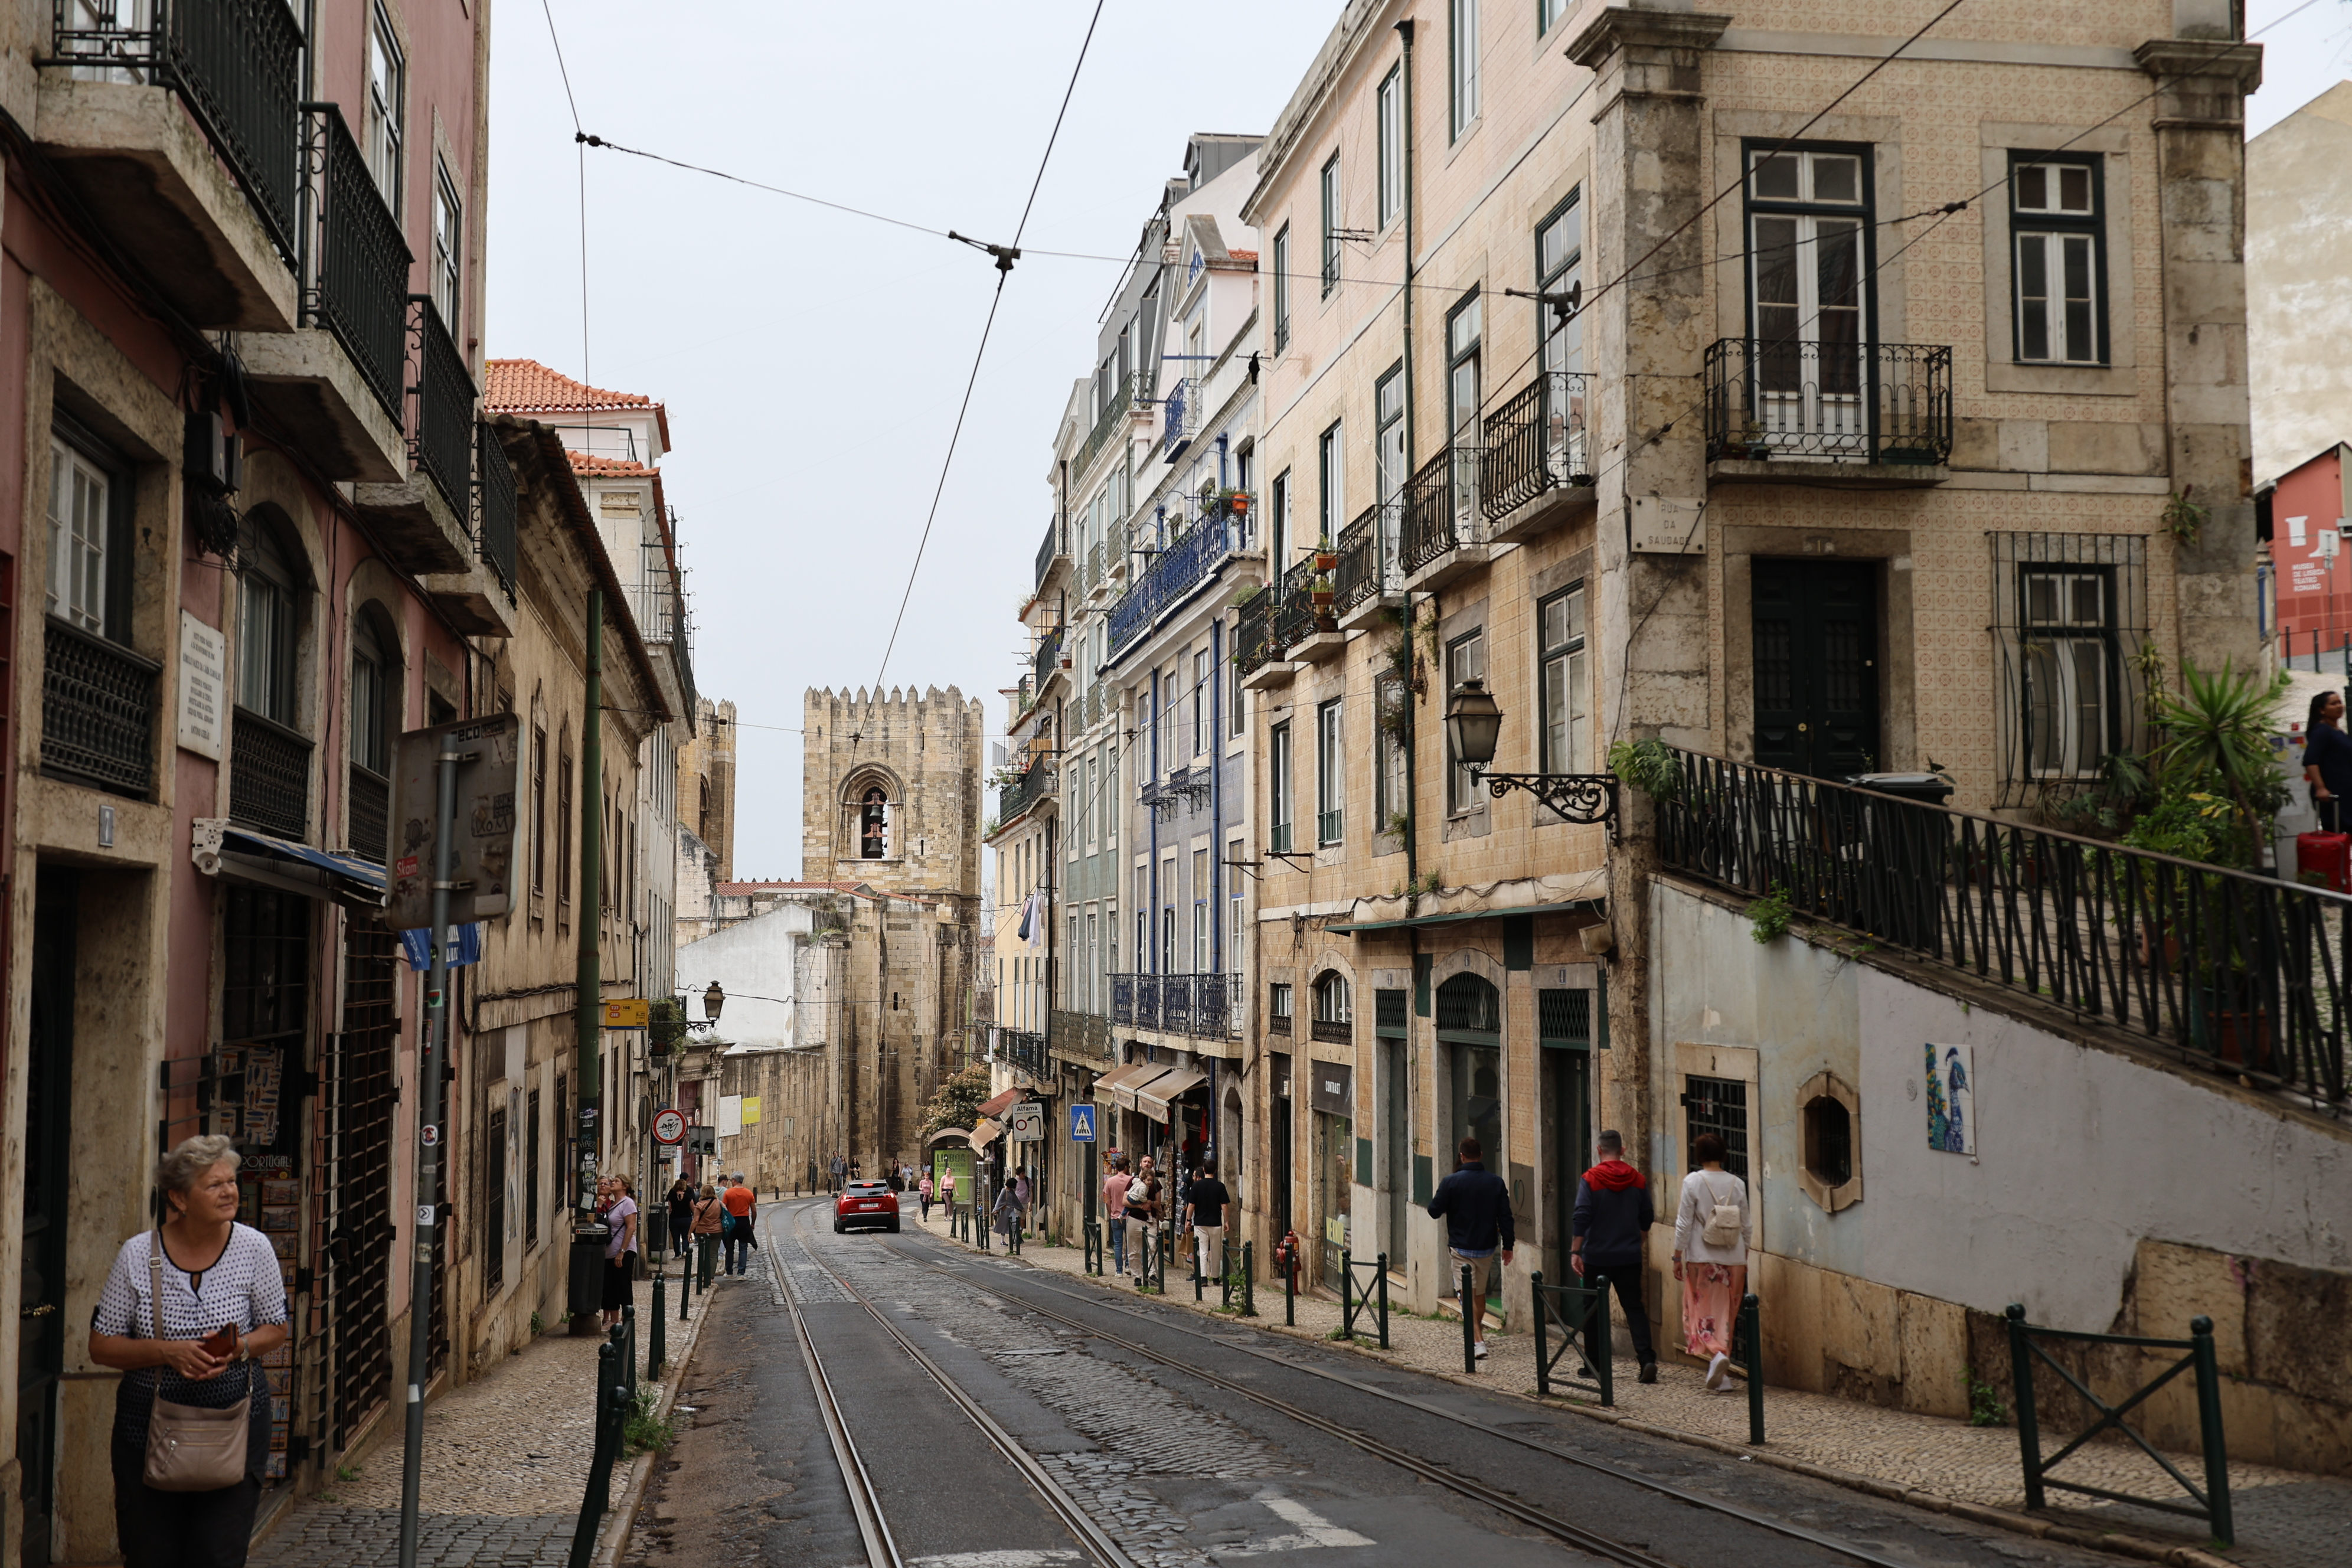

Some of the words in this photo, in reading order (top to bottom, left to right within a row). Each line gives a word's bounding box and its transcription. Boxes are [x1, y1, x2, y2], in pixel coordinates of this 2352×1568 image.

[1661, 504, 1679, 514] RUA
[1663, 520, 1676, 530] DA
[1648, 535, 1691, 546] SAUDADE
[2292, 562, 2315, 571] MUSEU
[2292, 576, 2318, 585] TEATRO
[2294, 583, 2322, 592] ROMANO
[1325, 1080, 1341, 1095] CONTRAST
[937, 1154, 966, 1162] LISBOA
